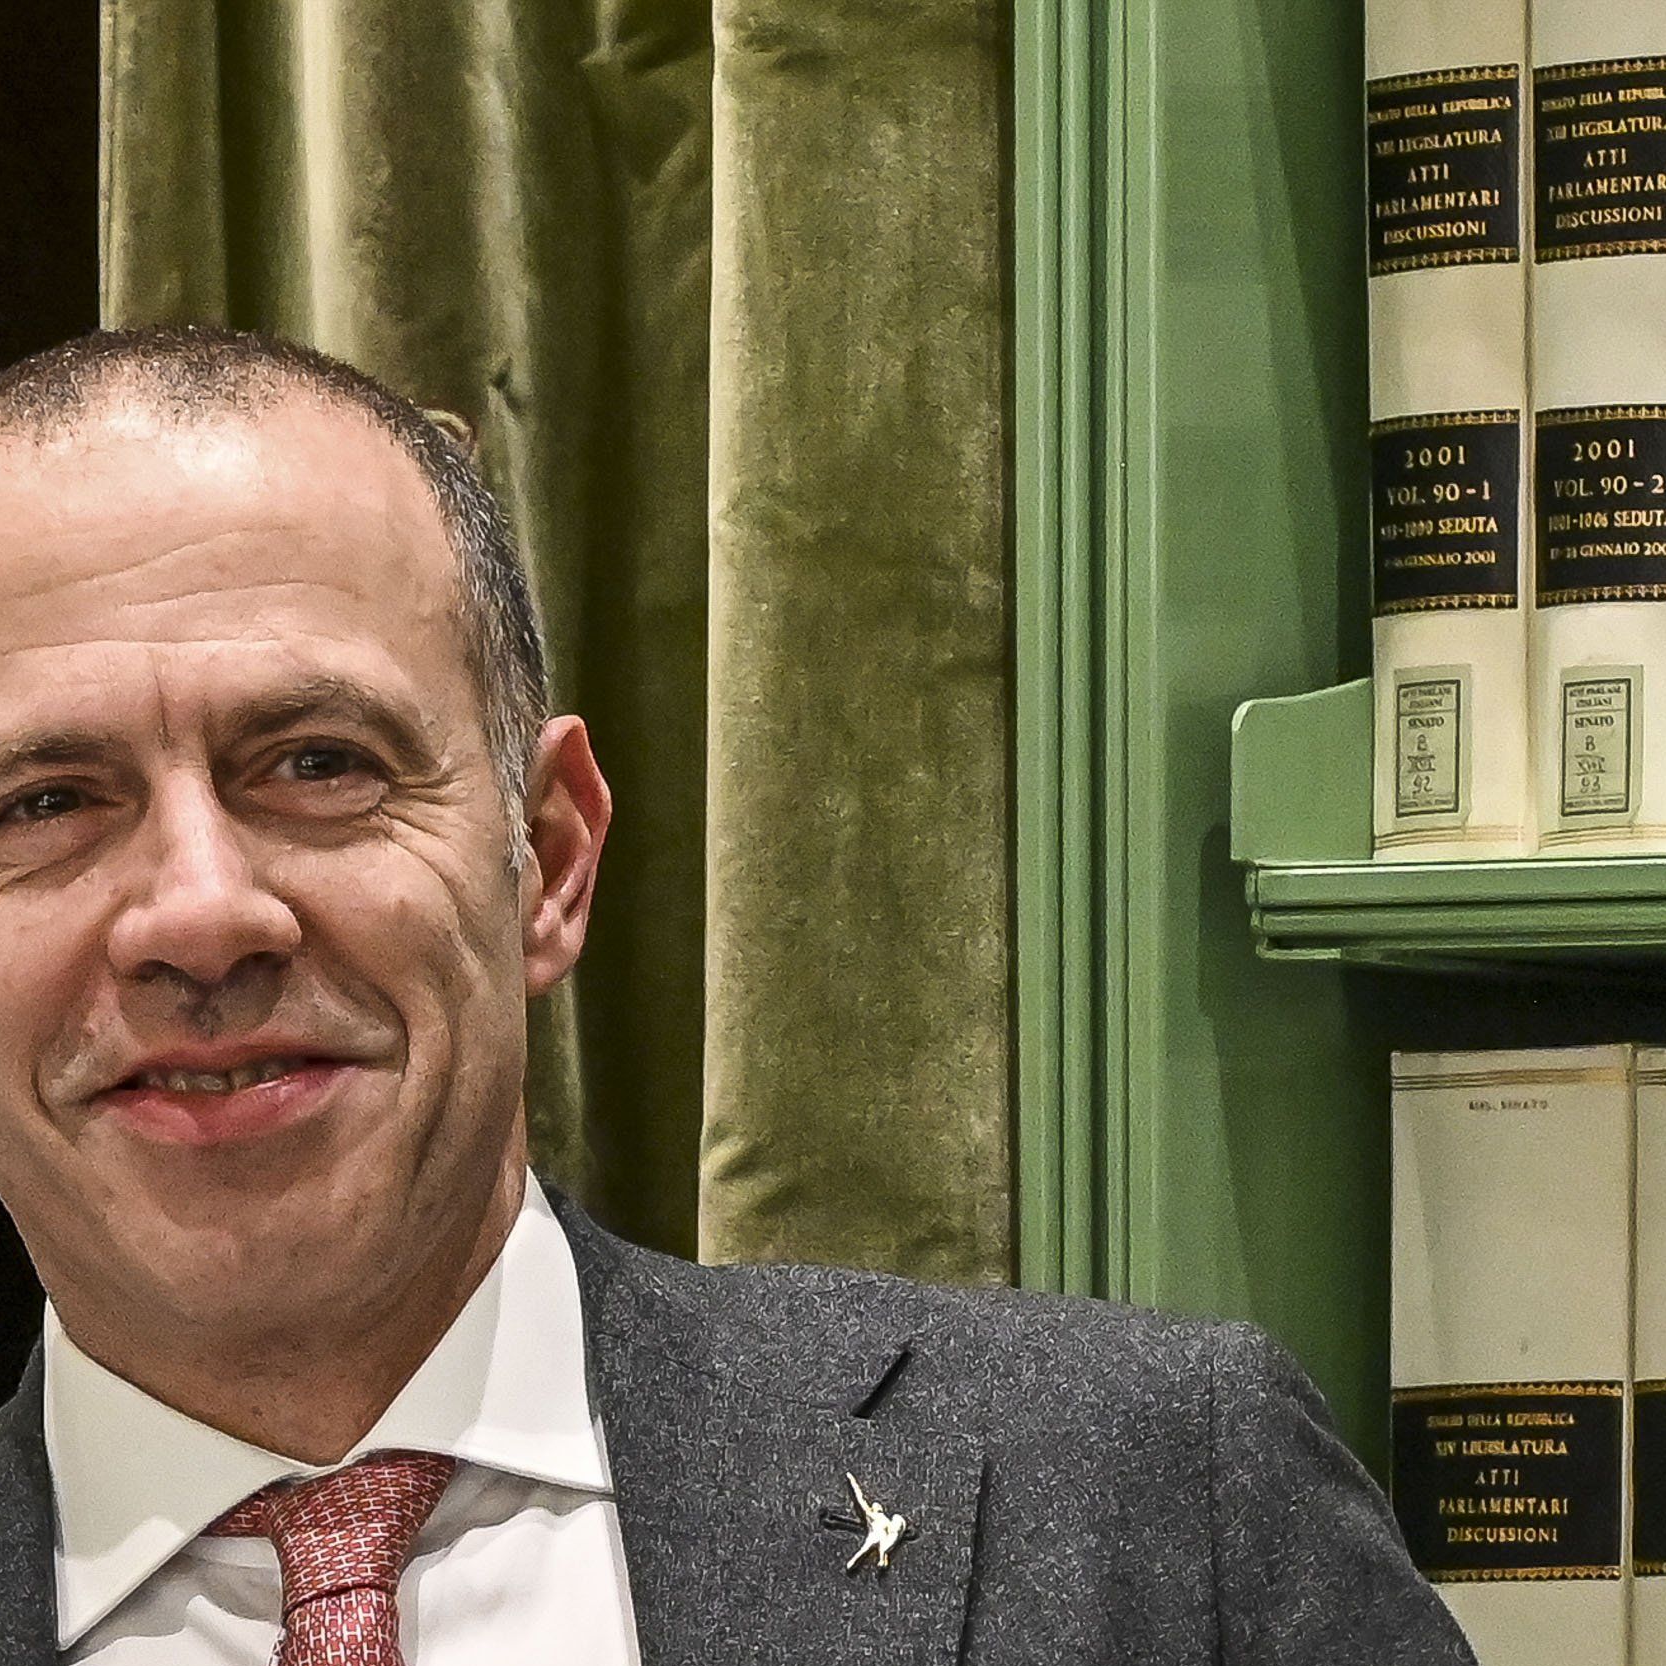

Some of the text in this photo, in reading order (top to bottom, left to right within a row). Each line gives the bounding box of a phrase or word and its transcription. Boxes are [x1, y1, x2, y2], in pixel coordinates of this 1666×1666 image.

[1586, 148, 1626, 167] ATTI
[1407, 163, 1448, 182] ATTI
[1556, 206, 1661, 228] DISCUSSIONI
[1407, 446, 1465, 468] 2001
[1574, 439, 1634, 461] 2001
[1439, 517, 1498, 534] SEDUTA
[1465, 551, 1495, 564] 2001
